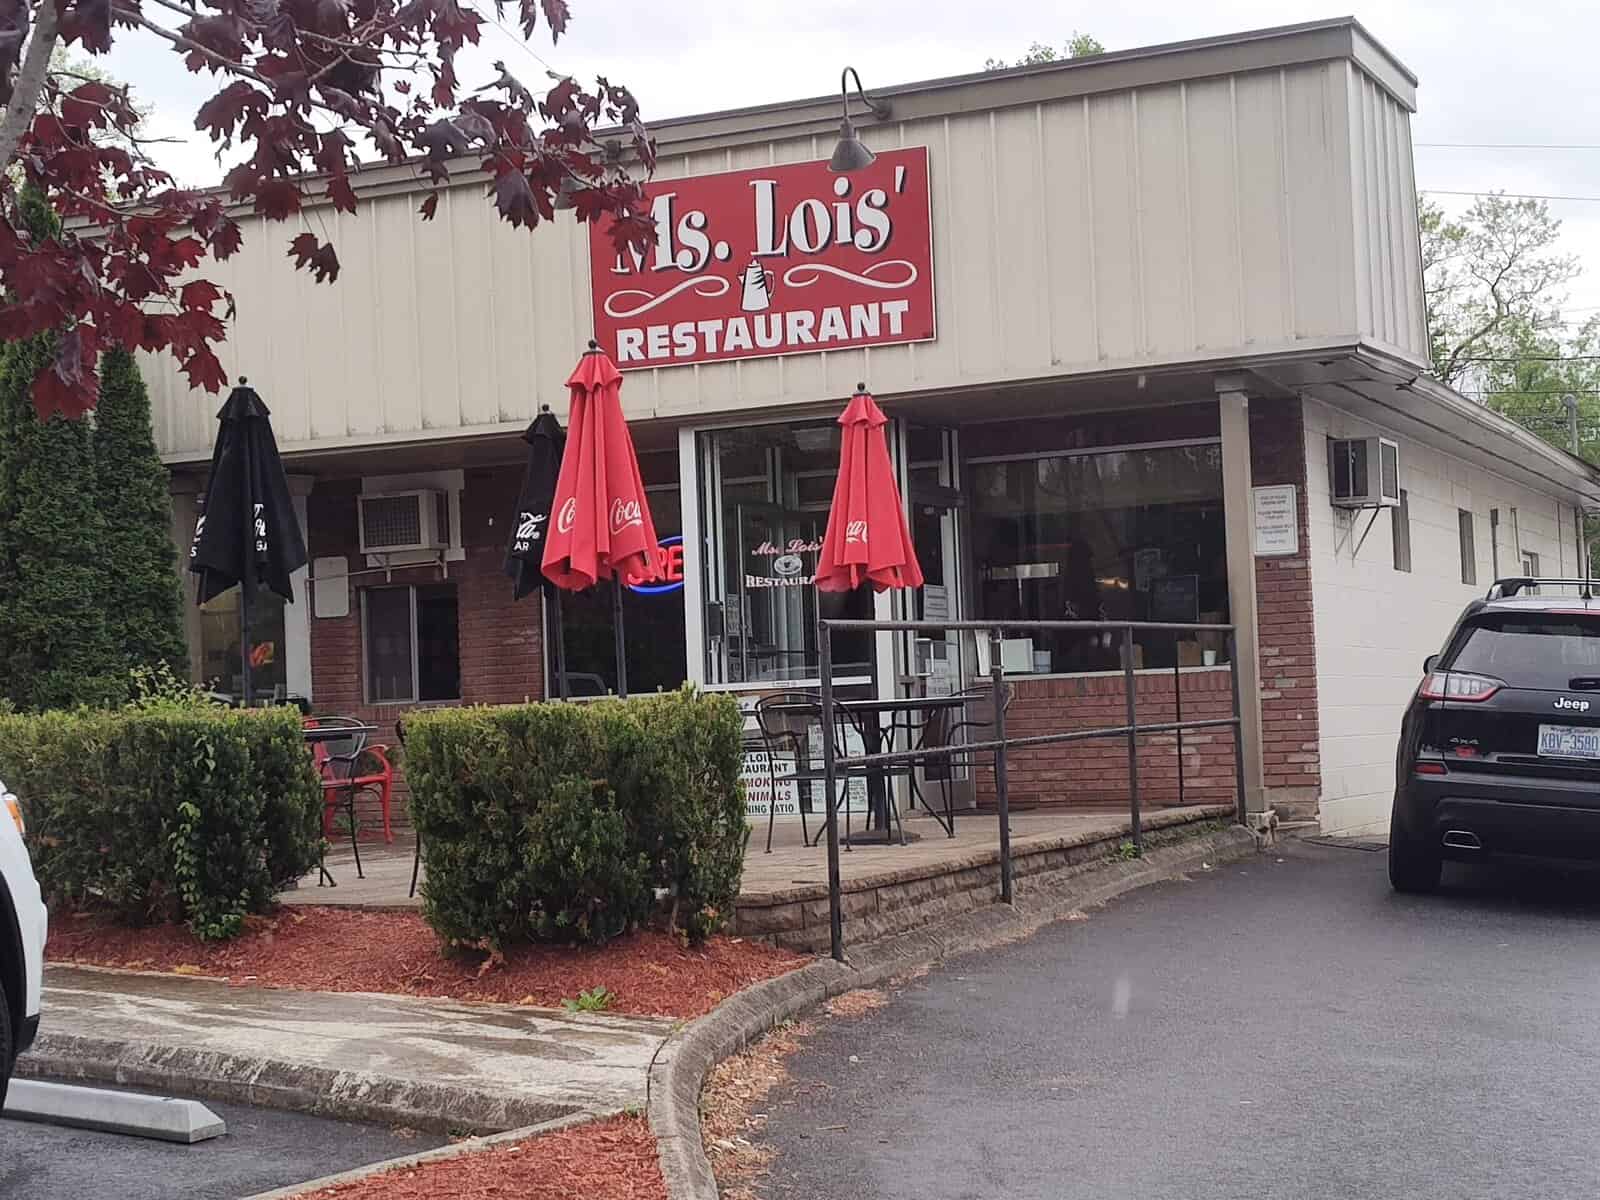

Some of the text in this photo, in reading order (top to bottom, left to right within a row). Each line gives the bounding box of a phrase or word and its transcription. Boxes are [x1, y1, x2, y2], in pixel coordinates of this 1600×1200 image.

[610, 165, 905, 273] Ms. Lois'
[616, 299, 909, 362] RESTAURANT
[745, 574, 816, 588] RESTAURA
[1554, 697, 1589, 711] Jeep
[747, 790, 791, 801] NIMALS
